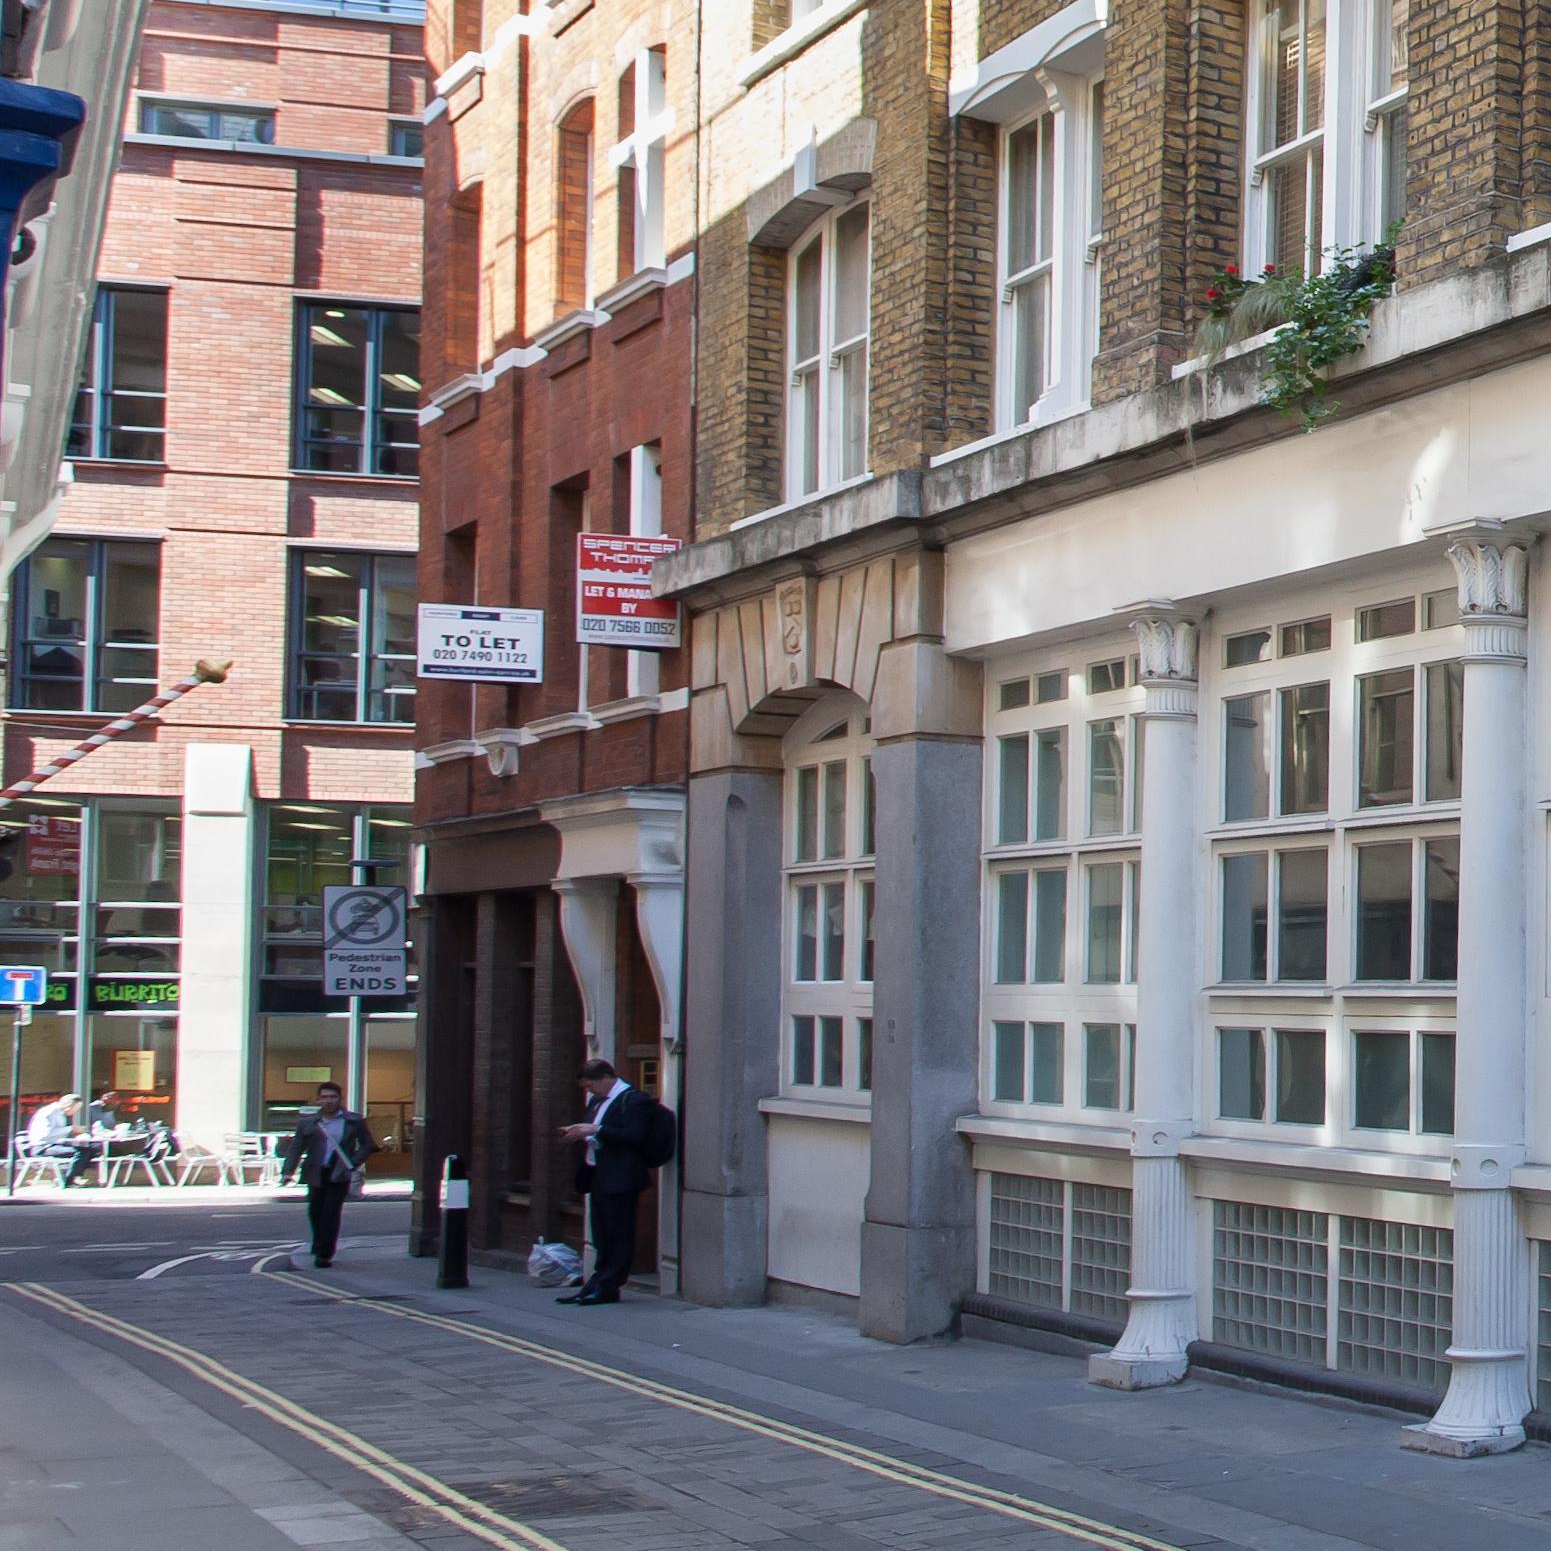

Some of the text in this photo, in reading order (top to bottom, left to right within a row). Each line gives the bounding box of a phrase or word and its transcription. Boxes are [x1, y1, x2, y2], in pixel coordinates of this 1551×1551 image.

[583, 538, 677, 554] SPENCER
[584, 585, 605, 597] LET
[617, 588, 652, 600] MANA
[620, 602, 638, 614] BY
[583, 618, 606, 631] 020
[609, 620, 641, 633] 7566
[441, 634, 521, 650] TO LET
[433, 649, 528, 664] 020 7490 1122
[329, 953, 402, 962] Pedestrian
[348, 964, 382, 973] Zone
[335, 977, 397, 991] ENDS
